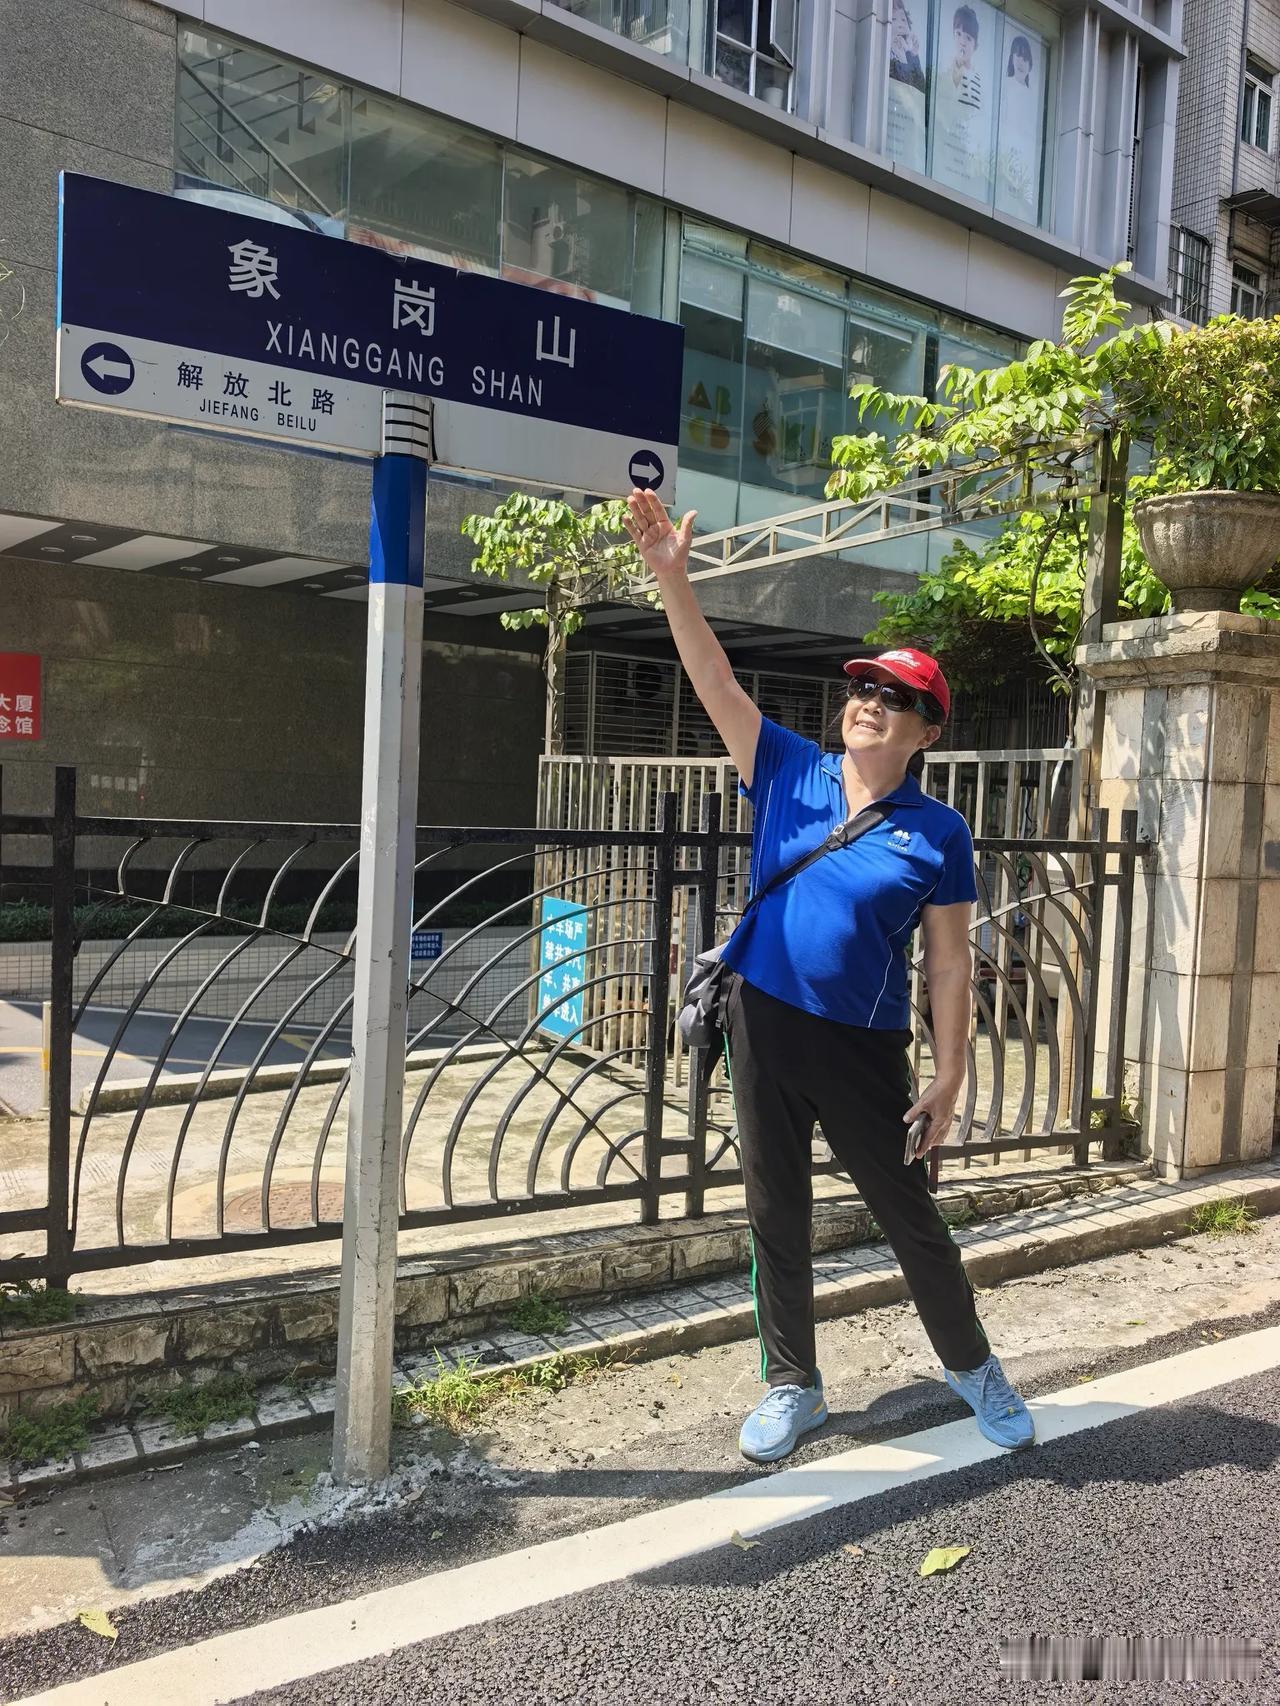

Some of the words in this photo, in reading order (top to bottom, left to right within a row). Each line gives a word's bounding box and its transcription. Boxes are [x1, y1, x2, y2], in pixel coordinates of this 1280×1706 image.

[228, 239, 576, 368] 象岗山
[265, 320, 444, 386] XIANGGANG
[472, 365, 543, 407] SHAN
[177, 361, 335, 415] 解放北路
[200, 398, 259, 421] JIEFANG
[277, 412, 317, 432] BEILU
[0, 692, 33, 712] 大厦
[0, 715, 33, 734] 念馆
